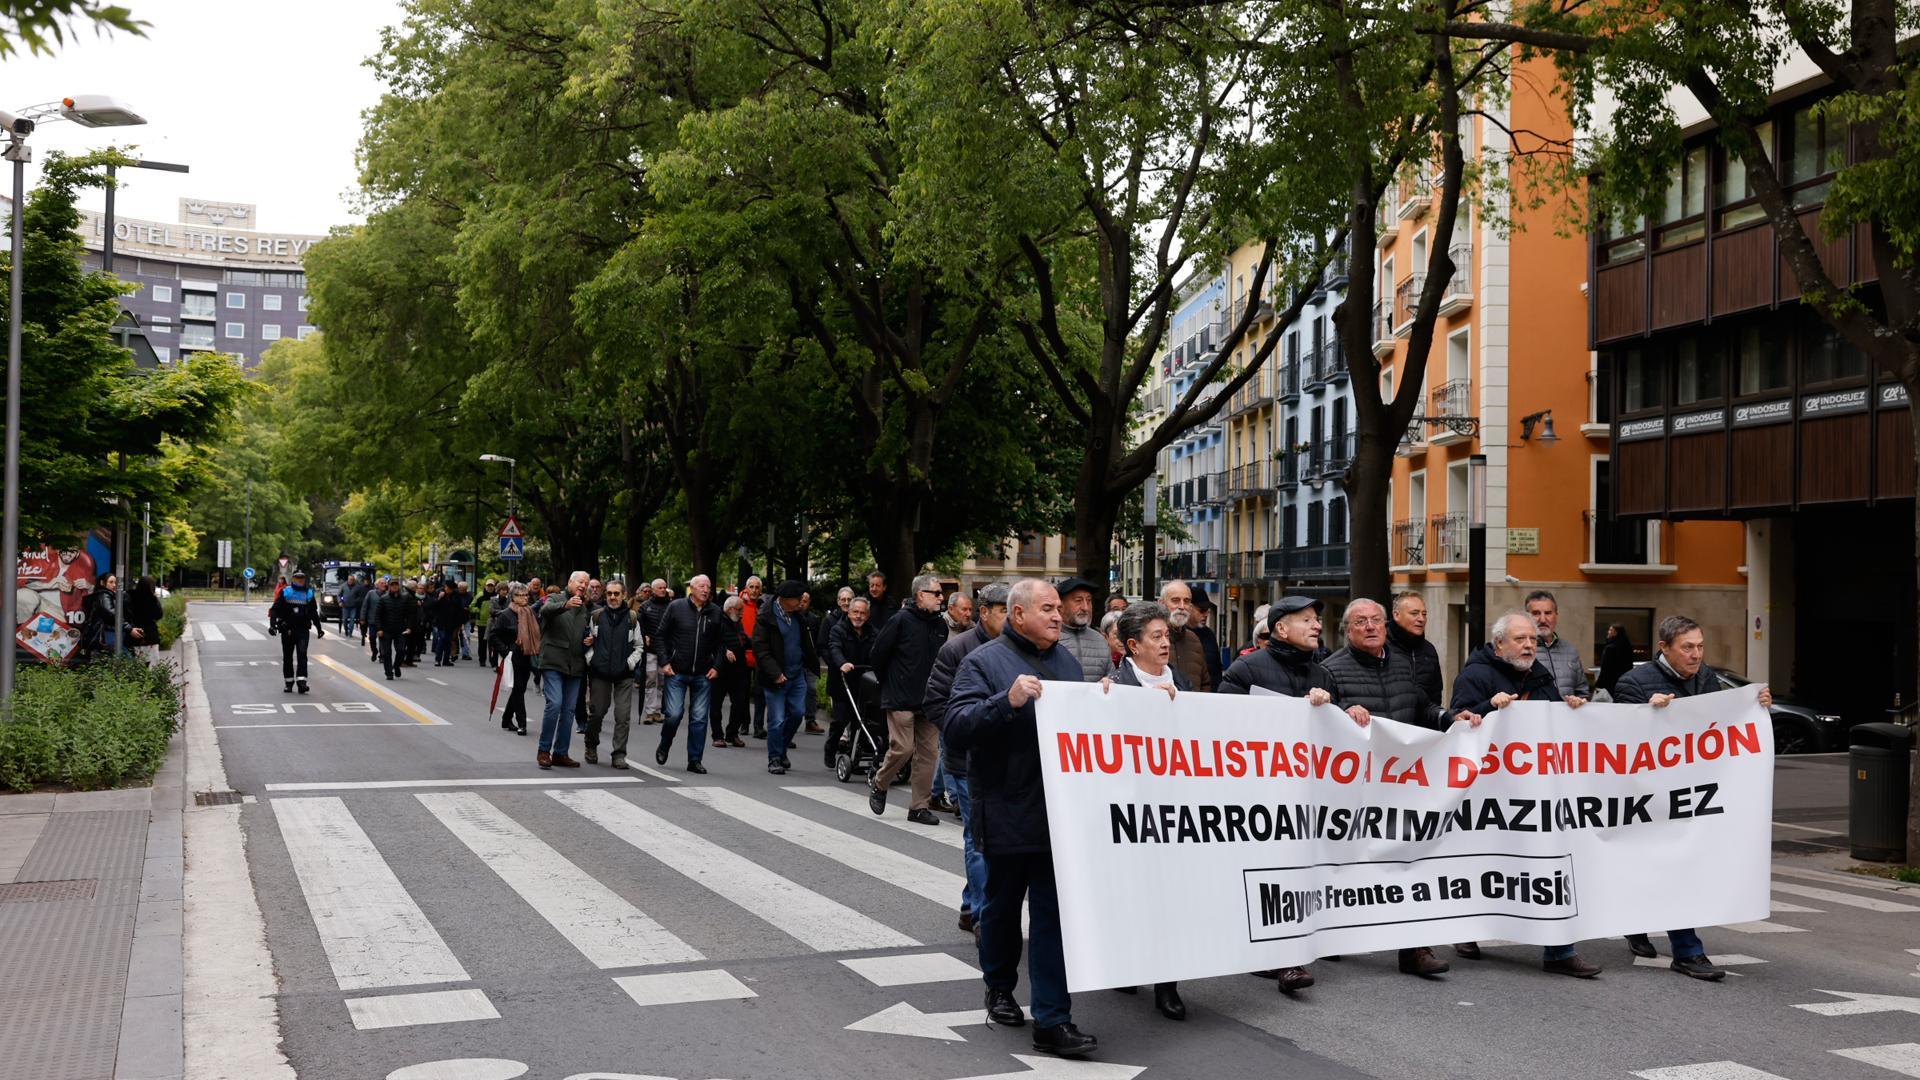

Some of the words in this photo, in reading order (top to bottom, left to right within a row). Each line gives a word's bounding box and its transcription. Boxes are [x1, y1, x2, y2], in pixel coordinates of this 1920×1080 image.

[185, 230, 249, 255] TRES
[1820, 391, 1866, 405] INDOSUEZ
[1749, 401, 1790, 416] INDOSUEZ
[1631, 419, 1664, 431] INDOSUEZ
[1687, 411, 1723, 425] INDOSUEZ
[66, 610, 86, 624] 10
[230, 702, 382, 715] BUS
[1056, 732, 1310, 779] MUTUALISTAS
[1380, 756, 1429, 787] LA
[1110, 803, 1310, 844] NAFARROAN
[1668, 782, 1725, 821] EZ
[1325, 884, 1405, 910] Frente
[1411, 882, 1432, 902] a
[1438, 875, 1472, 900] la
[1481, 869, 1572, 907] Crisis
